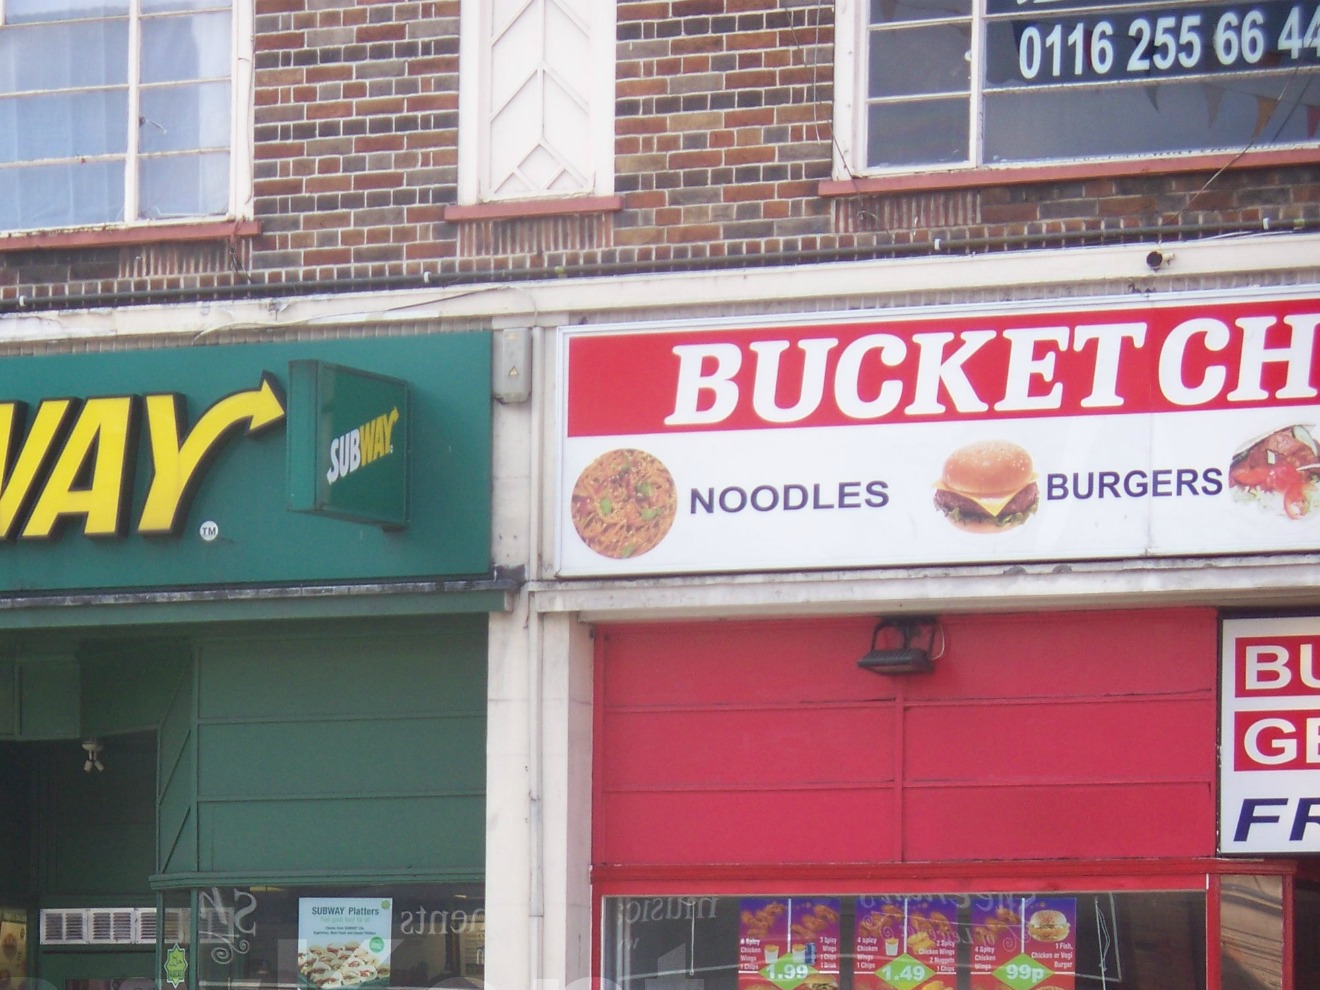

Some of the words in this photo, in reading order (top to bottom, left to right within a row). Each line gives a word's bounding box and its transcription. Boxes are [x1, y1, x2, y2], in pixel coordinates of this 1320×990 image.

[1019, 21, 1113, 79] 0116
[1127, 15, 1201, 71] 255
[1214, 10, 1264, 65] 66
[1278, 6, 1320, 59] 44
[664, 321, 1148, 427] BUCKET
[326, 405, 399, 485] SUBWAY
[1046, 467, 1223, 501] BURGERS
[689, 479, 890, 515] NOODLES
[312, 906, 345, 916] SUBWAY
[348, 906, 380, 916] Platters
[1031, 951, 1053, 959] Chicken
[766, 964, 809, 979] 1.99
[882, 965, 925, 980] 1.49
[1006, 964, 1045, 983] 99p
[1054, 961, 1073, 969] Burger
